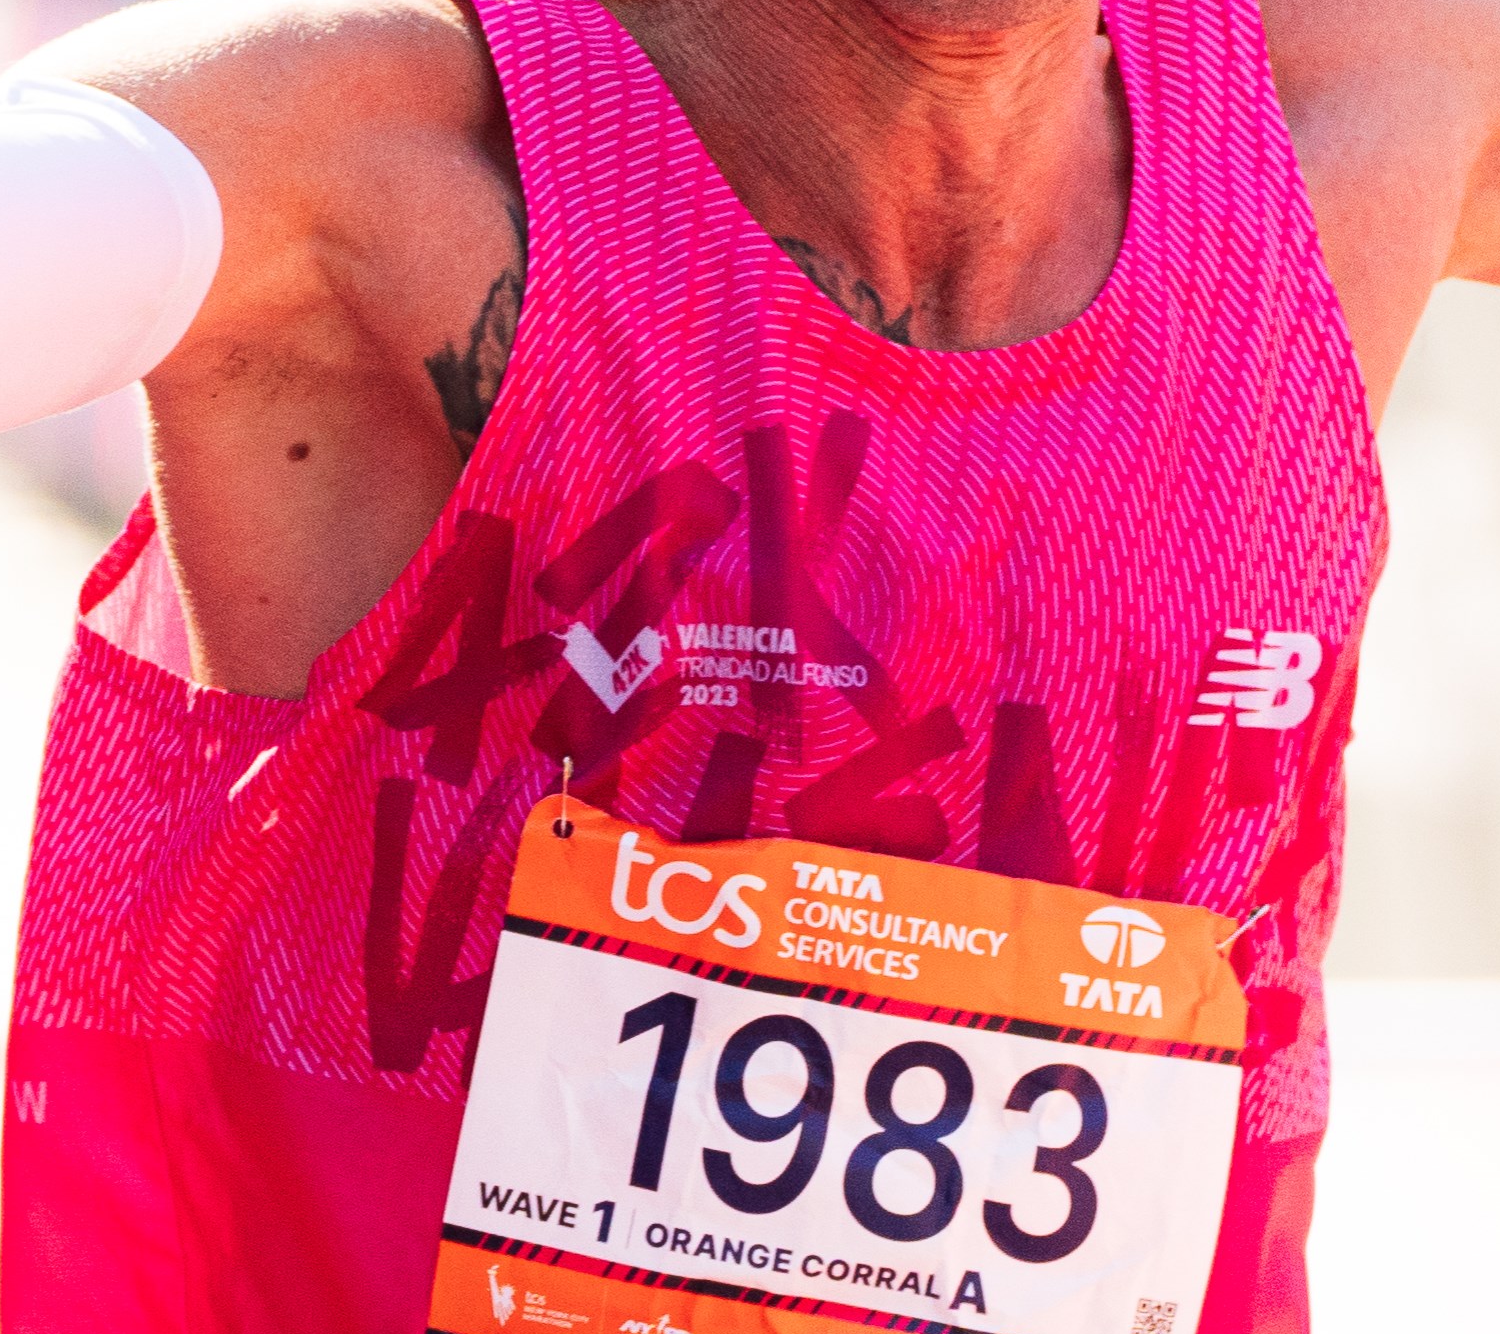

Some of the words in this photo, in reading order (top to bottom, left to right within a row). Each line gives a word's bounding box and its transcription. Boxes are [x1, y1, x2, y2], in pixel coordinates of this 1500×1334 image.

[676, 623, 798, 654] VALENCIA
[676, 656, 771, 682] TRINIDAD
[771, 662, 869, 687] ALFONSO
[679, 684, 739, 707] 2023
[610, 831, 768, 949] tcs
[792, 861, 884, 903] TATA
[783, 898, 1009, 958] CONSULTANCY
[777, 930, 920, 981] SERVICES
[1058, 972, 1164, 1019] TATA
[616, 991, 1109, 1264] 1983
[478, 1181, 579, 1229] WAVE
[592, 1201, 616, 1243] 1
[644, 1223, 792, 1274] ORANGE
[800, 1248, 943, 1300] CORRAL
[948, 1270, 988, 1315] A
